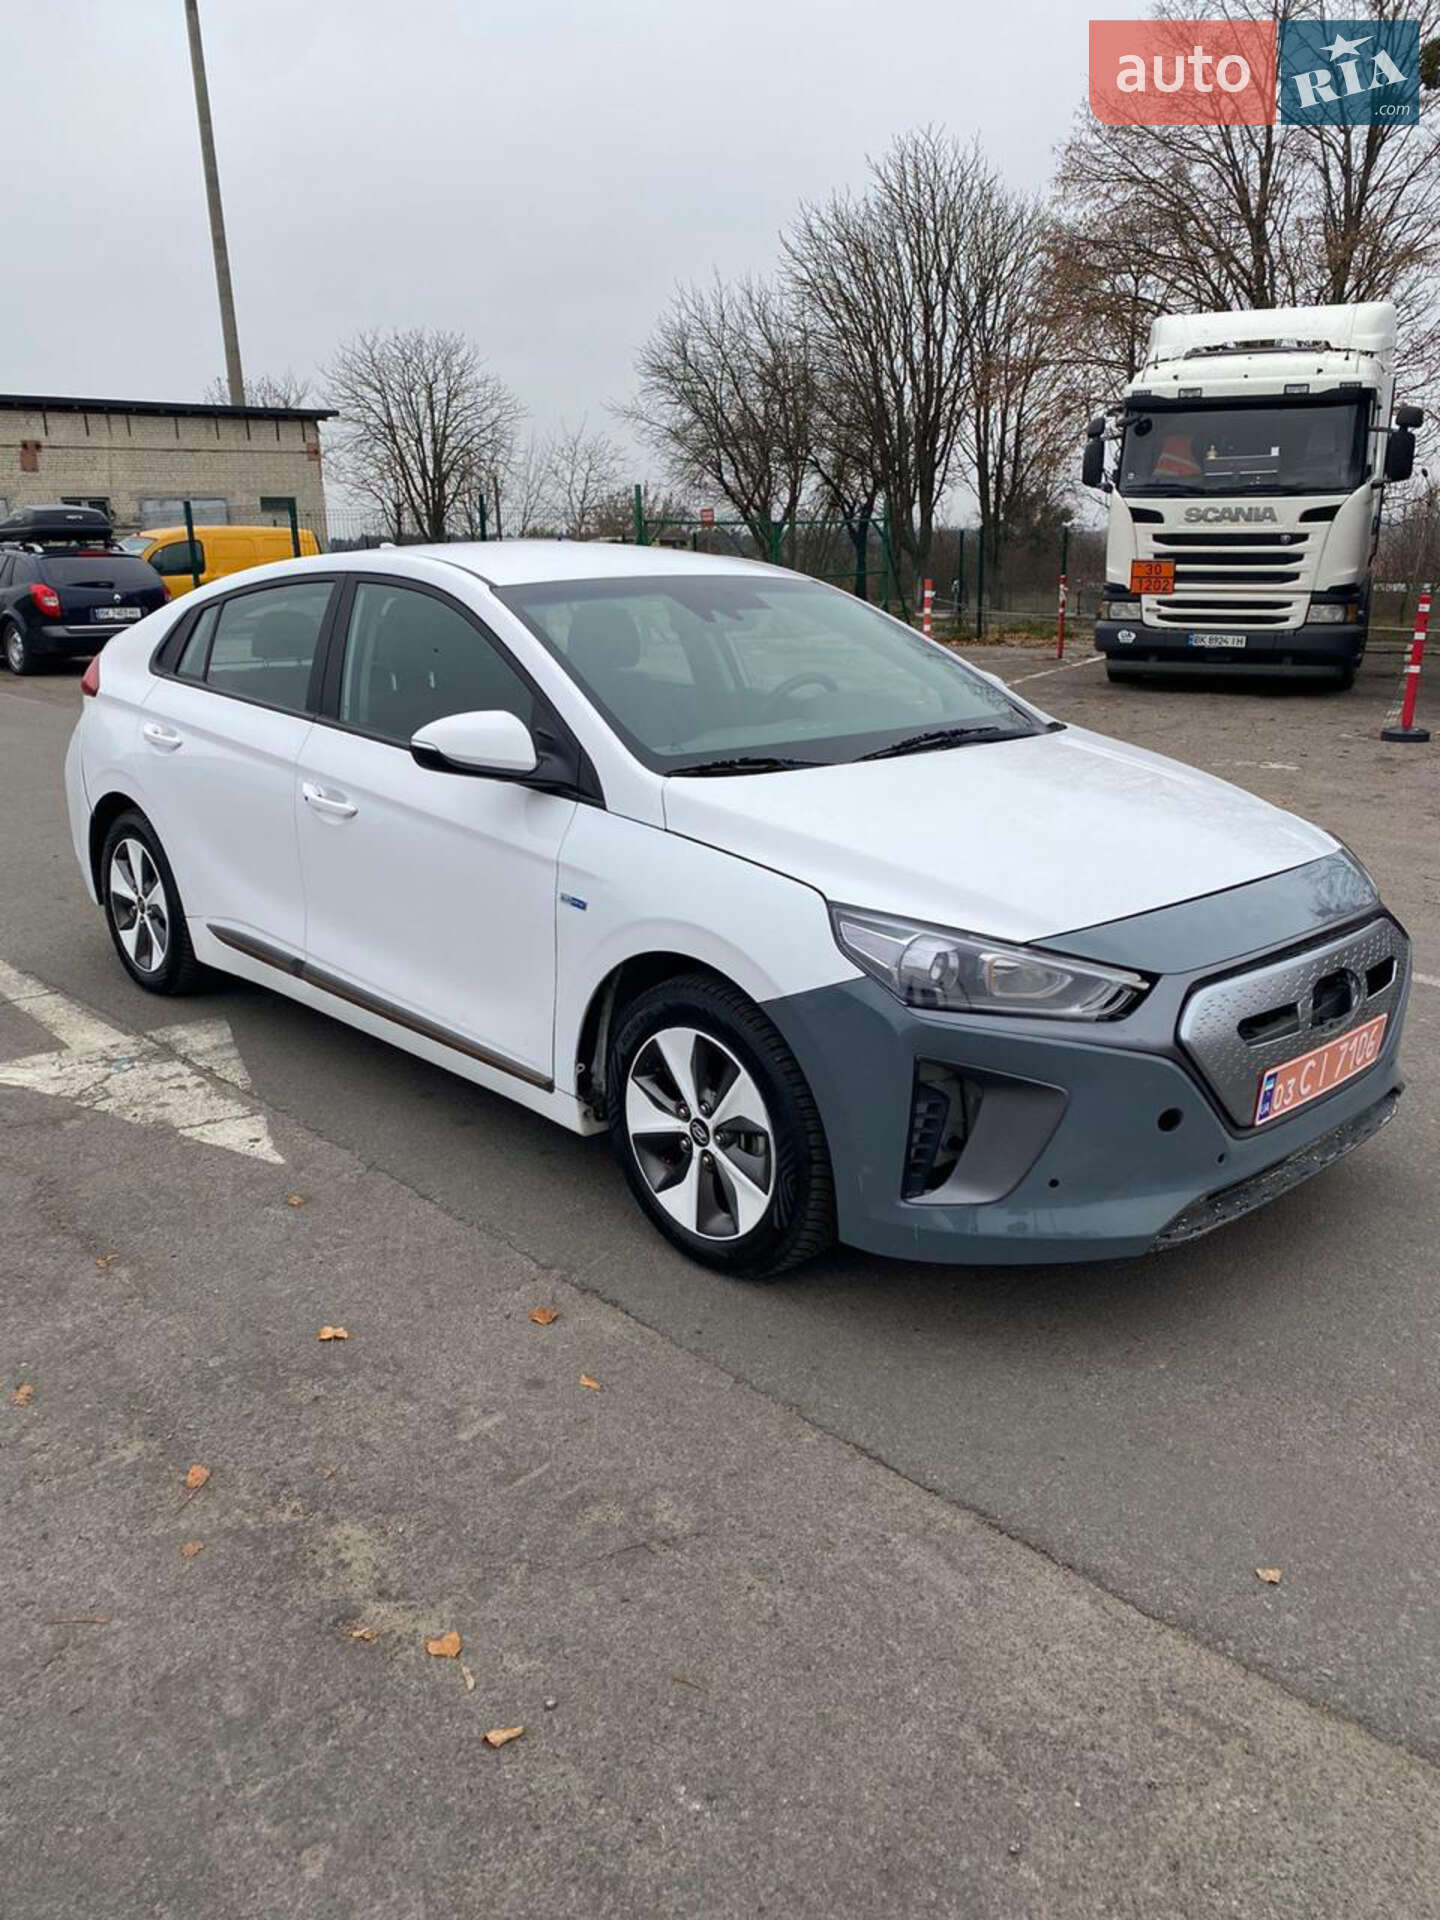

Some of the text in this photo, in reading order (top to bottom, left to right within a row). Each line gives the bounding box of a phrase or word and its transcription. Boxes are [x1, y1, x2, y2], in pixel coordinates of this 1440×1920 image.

[1184, 506, 1277, 523] SCANIA
[1144, 563, 1162, 575] 30
[1137, 579, 1170, 592] 1202
[1272, 1024, 1380, 1111] 03 CI 7106
